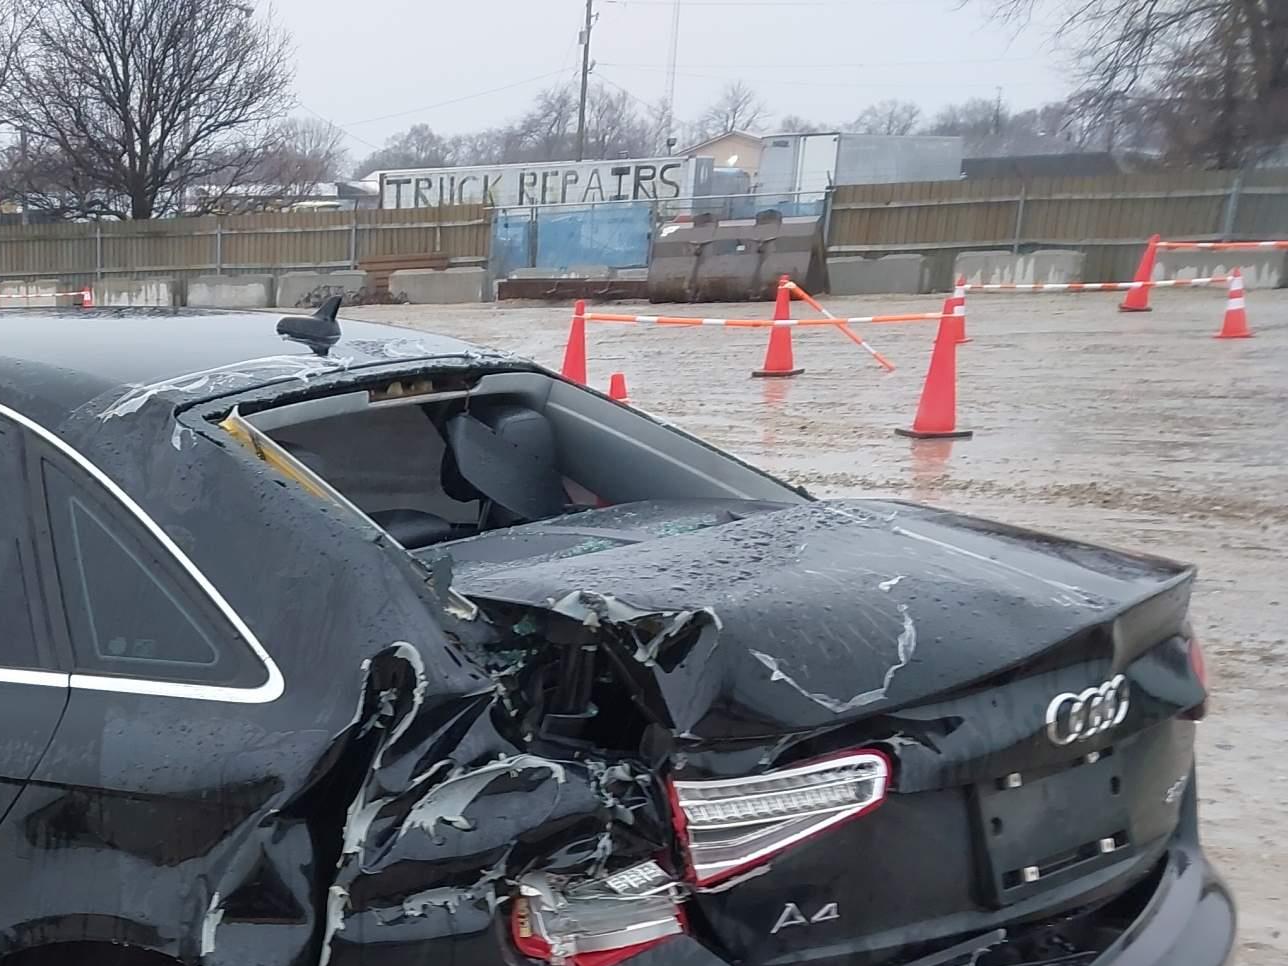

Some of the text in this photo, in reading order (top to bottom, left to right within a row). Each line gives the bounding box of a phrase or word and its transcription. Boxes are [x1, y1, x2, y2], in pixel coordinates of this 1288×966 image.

[385, 163, 682, 208] TRUCK REPAIRS
[770, 902, 841, 934] A4
